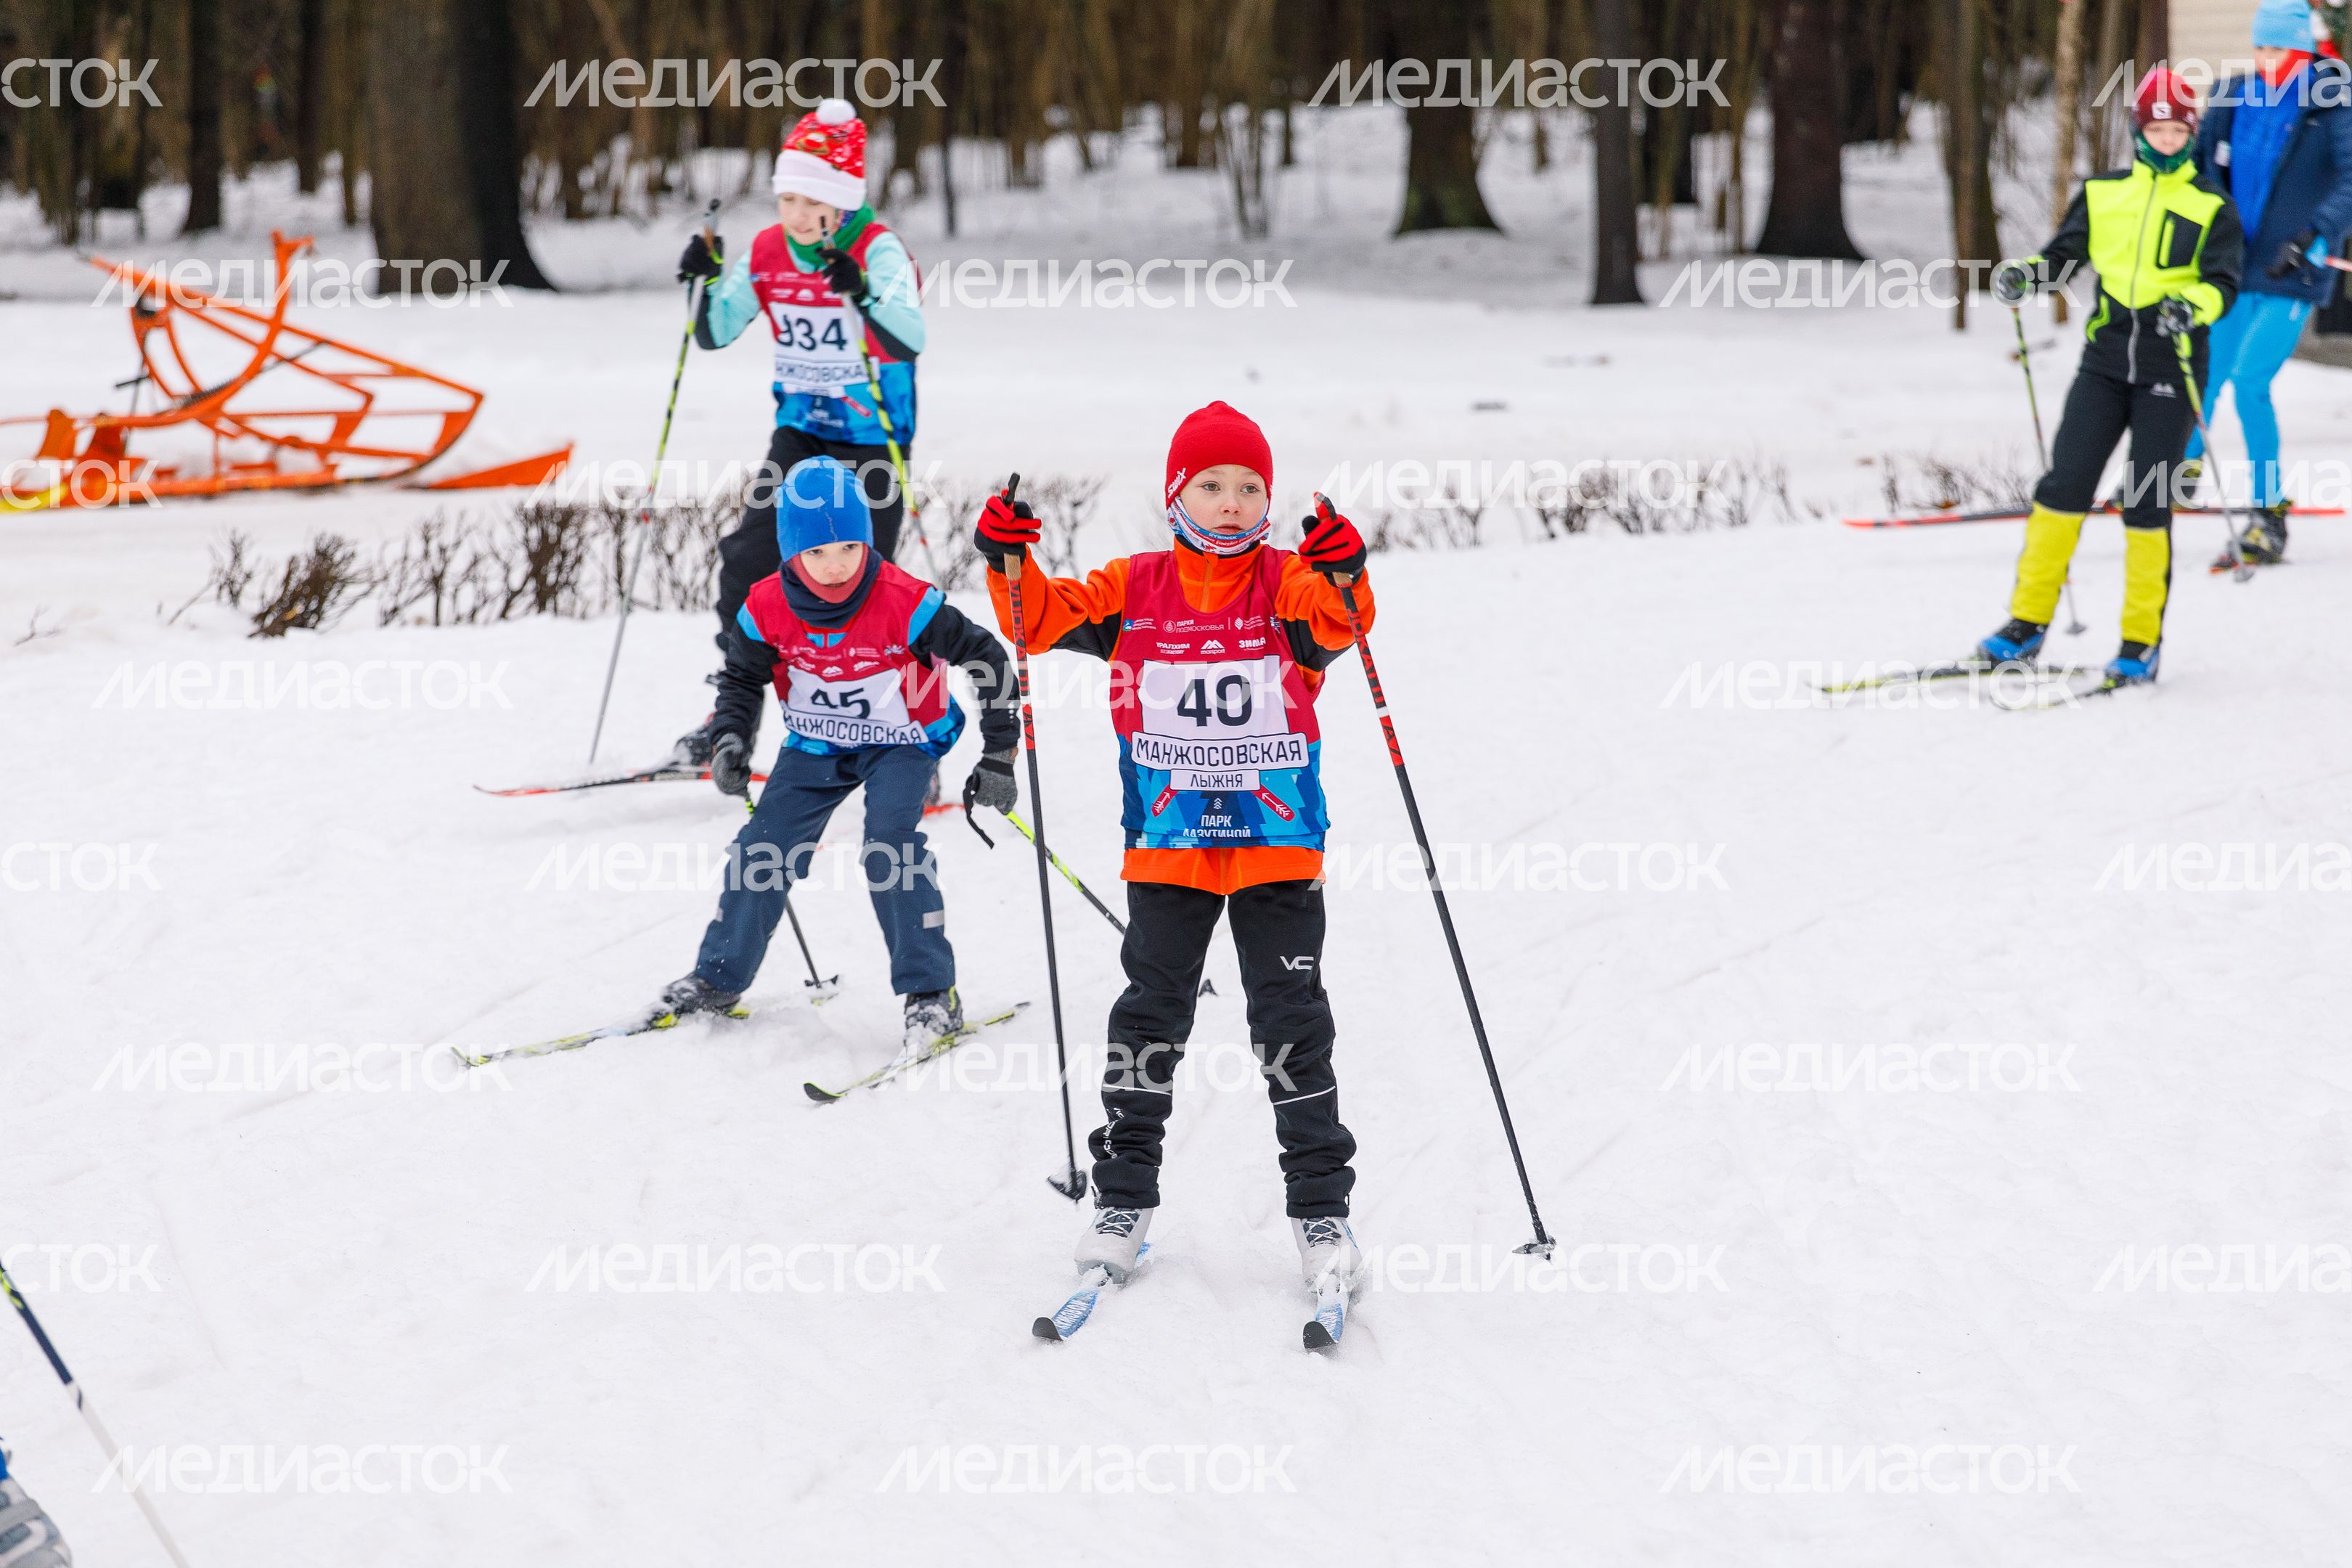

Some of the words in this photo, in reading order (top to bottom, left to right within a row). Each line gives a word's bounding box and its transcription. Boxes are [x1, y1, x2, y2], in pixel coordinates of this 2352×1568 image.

[1177, 674, 1252, 727] 40
[1137, 738, 1302, 767] МАНЖОСОВСКАЯ
[1191, 773, 1244, 788] ЛЫЖНЯ
[1201, 815, 1233, 828] ПАРК
[1279, 955, 1315, 971] VC
